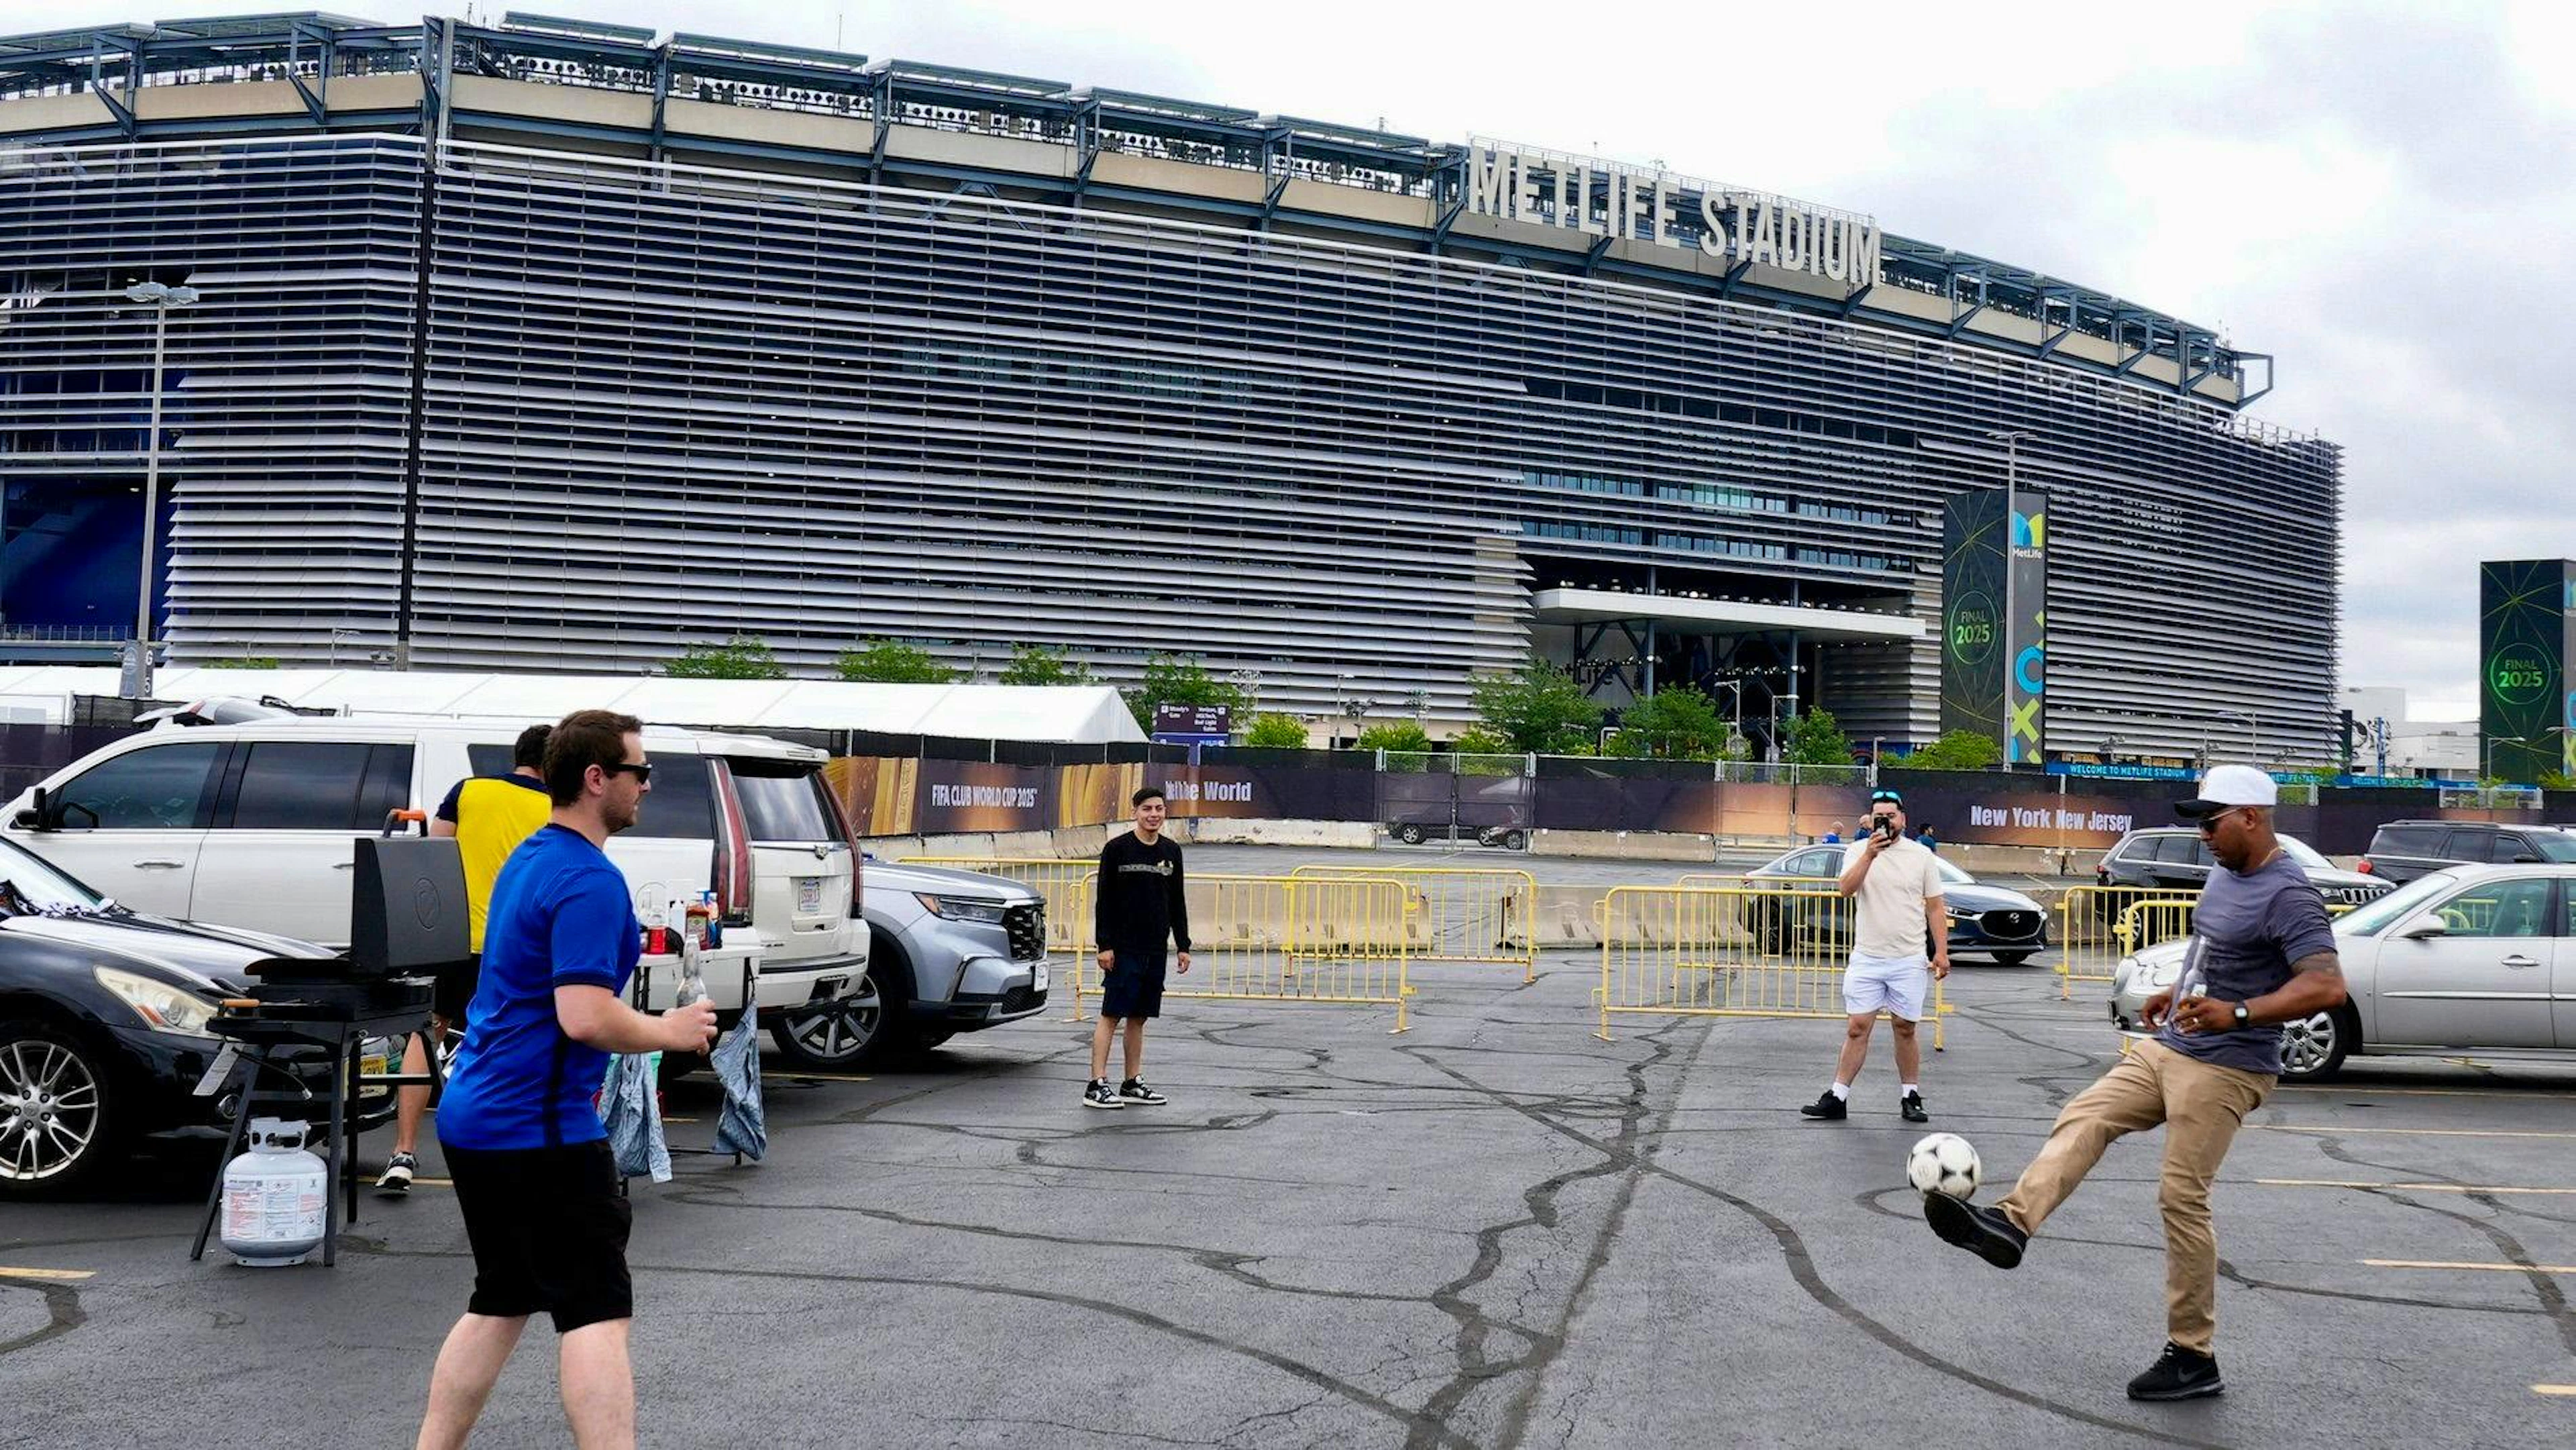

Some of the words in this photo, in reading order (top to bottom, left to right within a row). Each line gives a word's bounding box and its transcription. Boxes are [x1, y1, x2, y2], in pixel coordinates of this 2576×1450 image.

[1468, 146, 1680, 249] METLIFE
[1700, 190, 1880, 287] STADIUM
[2012, 548, 2043, 559] MetLife
[1961, 610, 1987, 623] FINAL
[1955, 624, 1990, 643] 2025
[2505, 658, 2538, 670] FINAL
[2498, 671, 2543, 688] 2025
[2070, 764, 2106, 775] WELCOME
[2109, 766, 2120, 776] TO
[2121, 766, 2153, 776] METLIFE
[2155, 768, 2187, 778] STADIUM
[932, 784, 950, 807] FIFA
[951, 784, 972, 807] CLUB
[973, 786, 1002, 807] WORLD
[1002, 787, 1017, 808] CUP
[1203, 780, 1252, 802] World
[1970, 805, 2008, 827] New
[2012, 807, 2051, 829] York
[2055, 809, 2085, 830] New
[2088, 811, 2133, 832] Jersey
